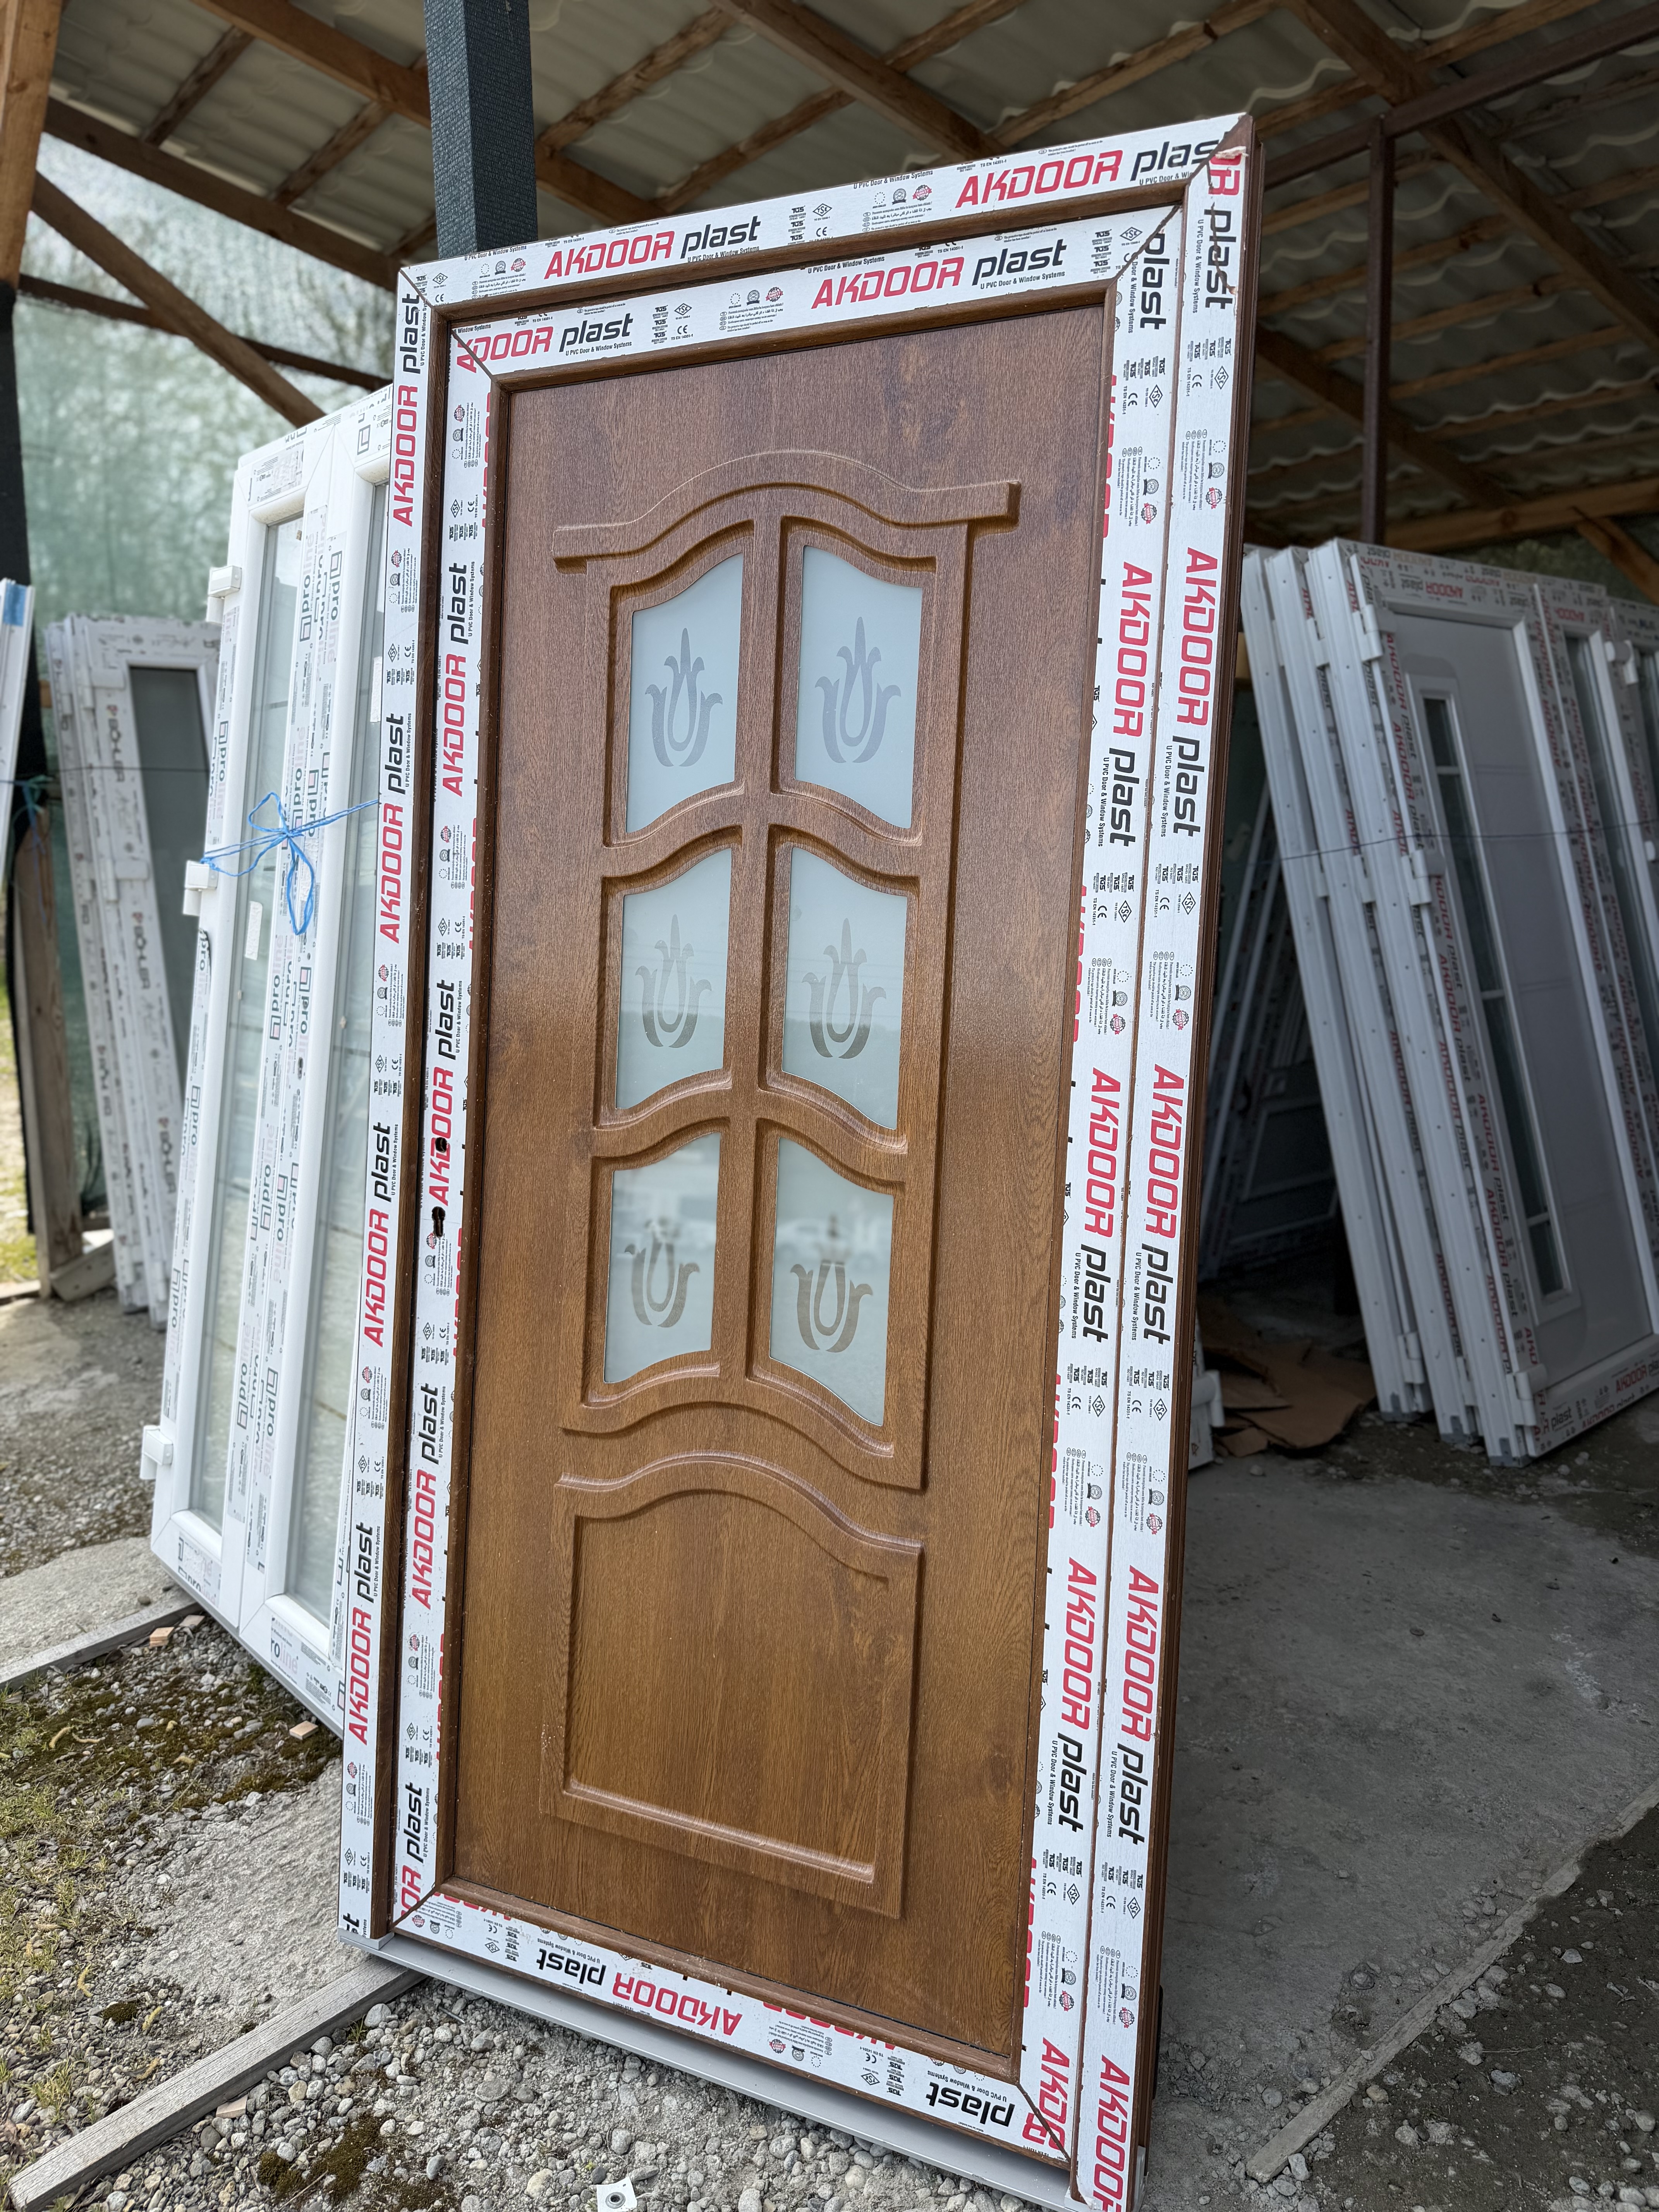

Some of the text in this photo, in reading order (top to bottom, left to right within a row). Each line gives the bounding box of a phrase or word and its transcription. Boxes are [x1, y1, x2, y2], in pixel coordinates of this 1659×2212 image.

[955, 139, 1219, 208] AKDOOR plas
[544, 215, 761, 279] AKDOOR plast
[811, 239, 1067, 309] AKDOOR plast
[1042, 271, 1065, 280] Systems
[1204, 206, 1237, 309] plast
[400, 293, 421, 374] plast
[559, 313, 634, 352] plast
[1127, 393, 1138, 407] CE
[393, 385, 417, 527] AKDOOR
[447, 563, 469, 645] plast
[1177, 548, 1218, 726] AKDOOR
[1113, 562, 1152, 737] AKDOOR
[385, 713, 406, 795] plast
[442, 654, 466, 797] AKDOOR
[1109, 747, 1140, 847] plast
[1172, 735, 1205, 837] plast
[380, 803, 403, 943] AKDOOR
[1097, 905, 1108, 918] CE
[1159, 897, 1170, 910] CE
[435, 979, 456, 1060] plast
[371, 1122, 392, 1202] plast
[428, 1067, 453, 1206] AKDOOR
[1084, 1068, 1121, 1238] AKDOOR
[1146, 1065, 1184, 1239] AKDOOR
[364, 1209, 388, 1347] AKDOOR
[1080, 1243, 1111, 1343] plast
[1141, 1243, 1173, 1345] plast
[418, 1383, 439, 1465] plast
[1071, 1396, 1081, 1410] CE
[1132, 1400, 1142, 1413] CE
[354, 1522, 374, 1604] plast
[412, 1470, 436, 1609] AKDOOR
[349, 1607, 371, 1745] AKDOOR
[1061, 1558, 1097, 1730] AKDOOR
[1121, 1566, 1159, 1742] AKDOOR
[404, 1782, 424, 1864] plast
[1058, 1732, 1087, 1832] plast
[1117, 1743, 1148, 1845] plast
[1106, 1896, 1116, 1909] CE
[536, 1948, 606, 1986] plast
[612, 1973, 742, 2036] AKDOOR
[926, 2081, 1015, 2127] plast
[927, 2070, 948, 2082] Systems
[950, 2078, 970, 2090] Window
[977, 2087, 989, 2096] Door
[991, 2092, 1001, 2100] PVC
